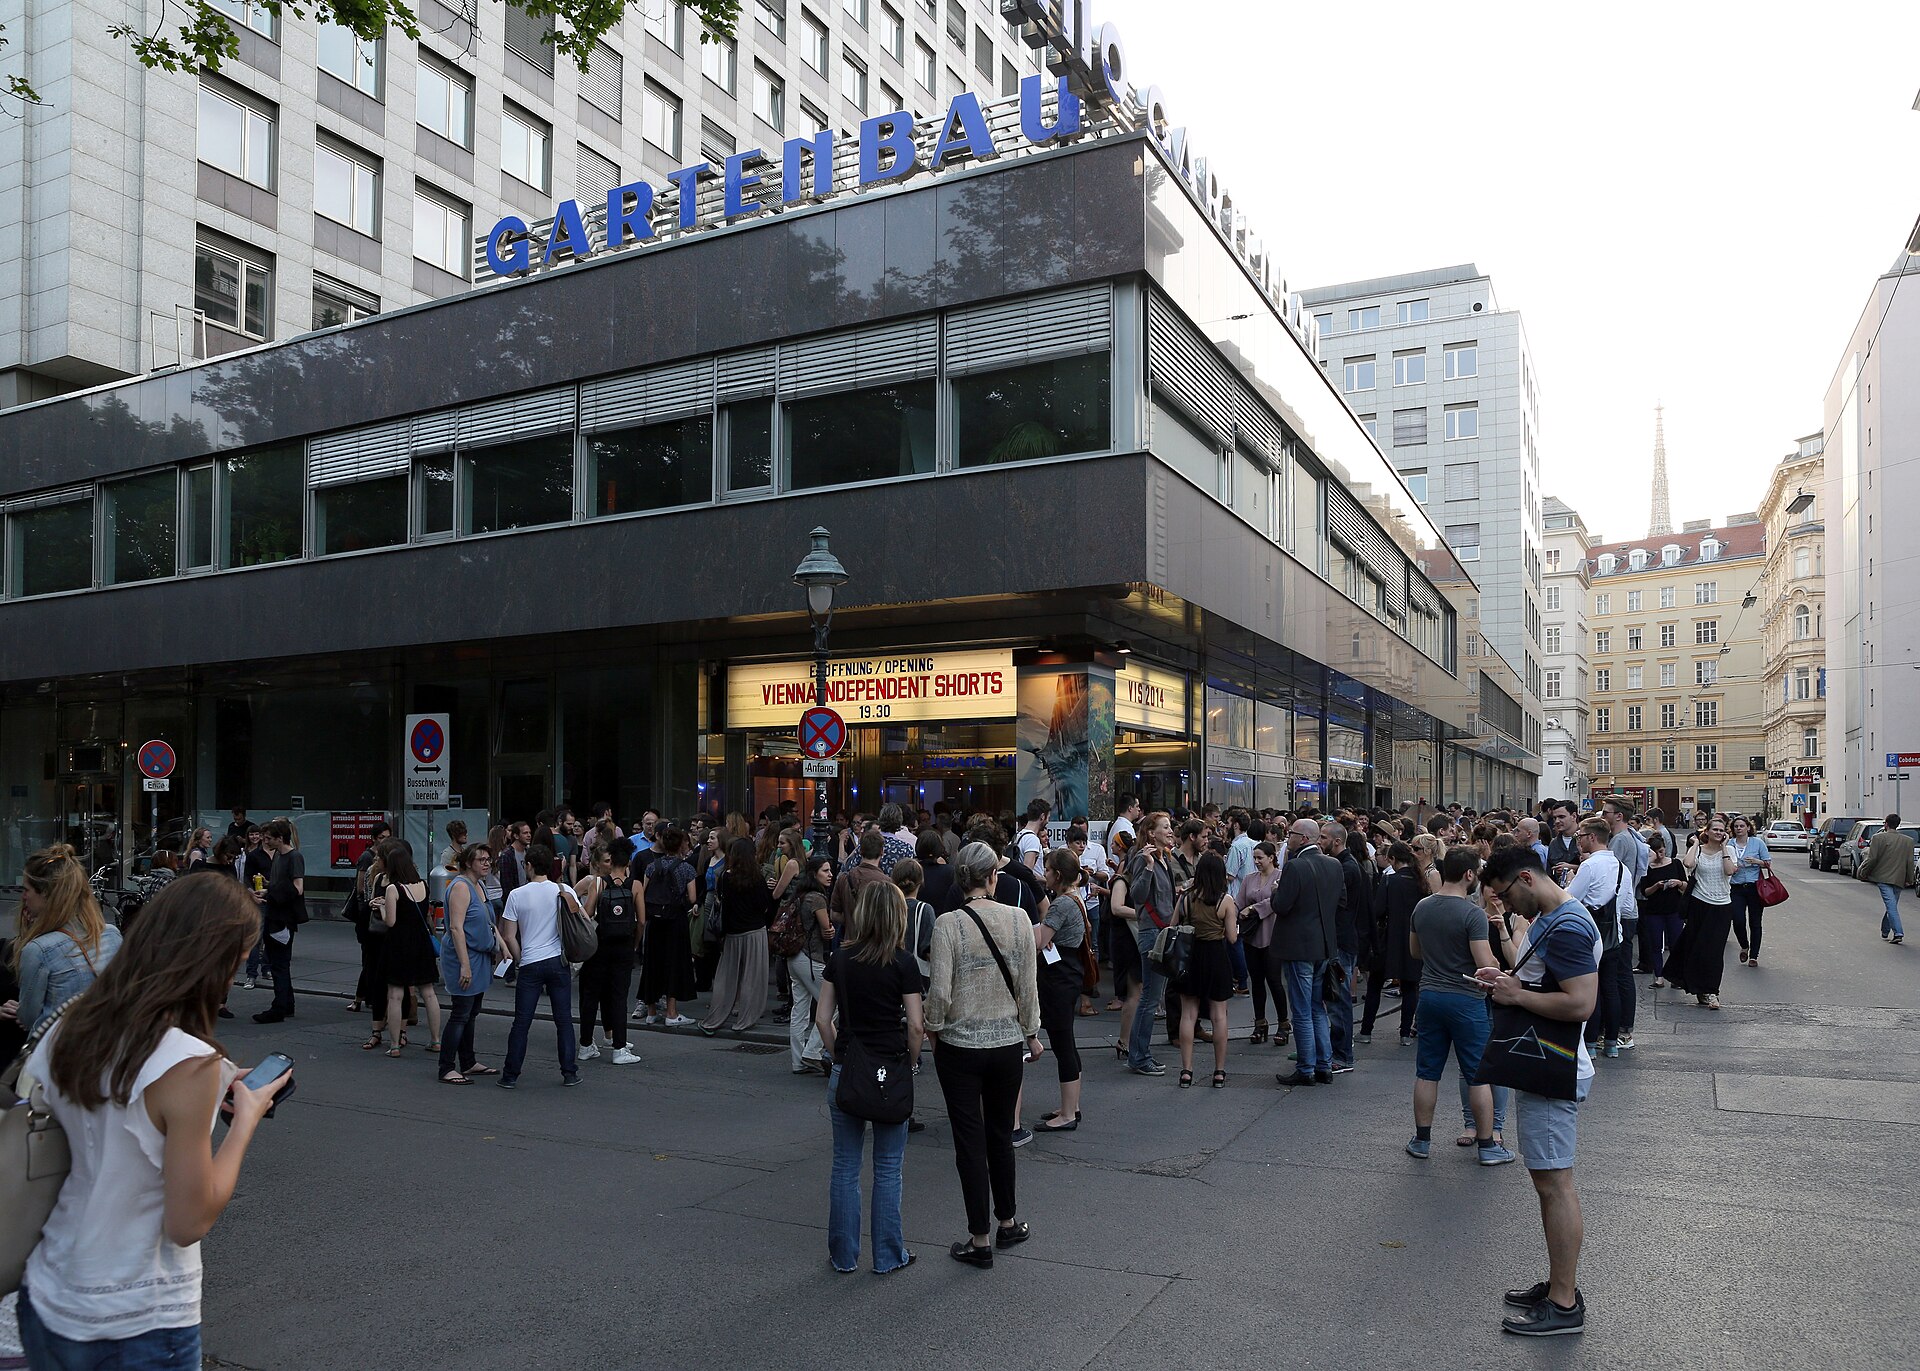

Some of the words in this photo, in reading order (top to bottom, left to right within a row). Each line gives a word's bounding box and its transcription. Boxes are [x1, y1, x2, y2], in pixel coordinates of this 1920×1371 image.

[487, 72, 1080, 275] GARTENBAU
[875, 661, 882, 674] /
[885, 658, 934, 674] OPENING
[762, 682, 818, 706] VIENNA
[824, 675, 931, 703] NDEPENDENT
[934, 671, 1003, 697] SHORTS
[1128, 680, 1143, 704] VIS
[1145, 685, 1165, 708] 2014
[859, 704, 891, 719] 19.30
[415, 790, 439, 800] bereich
